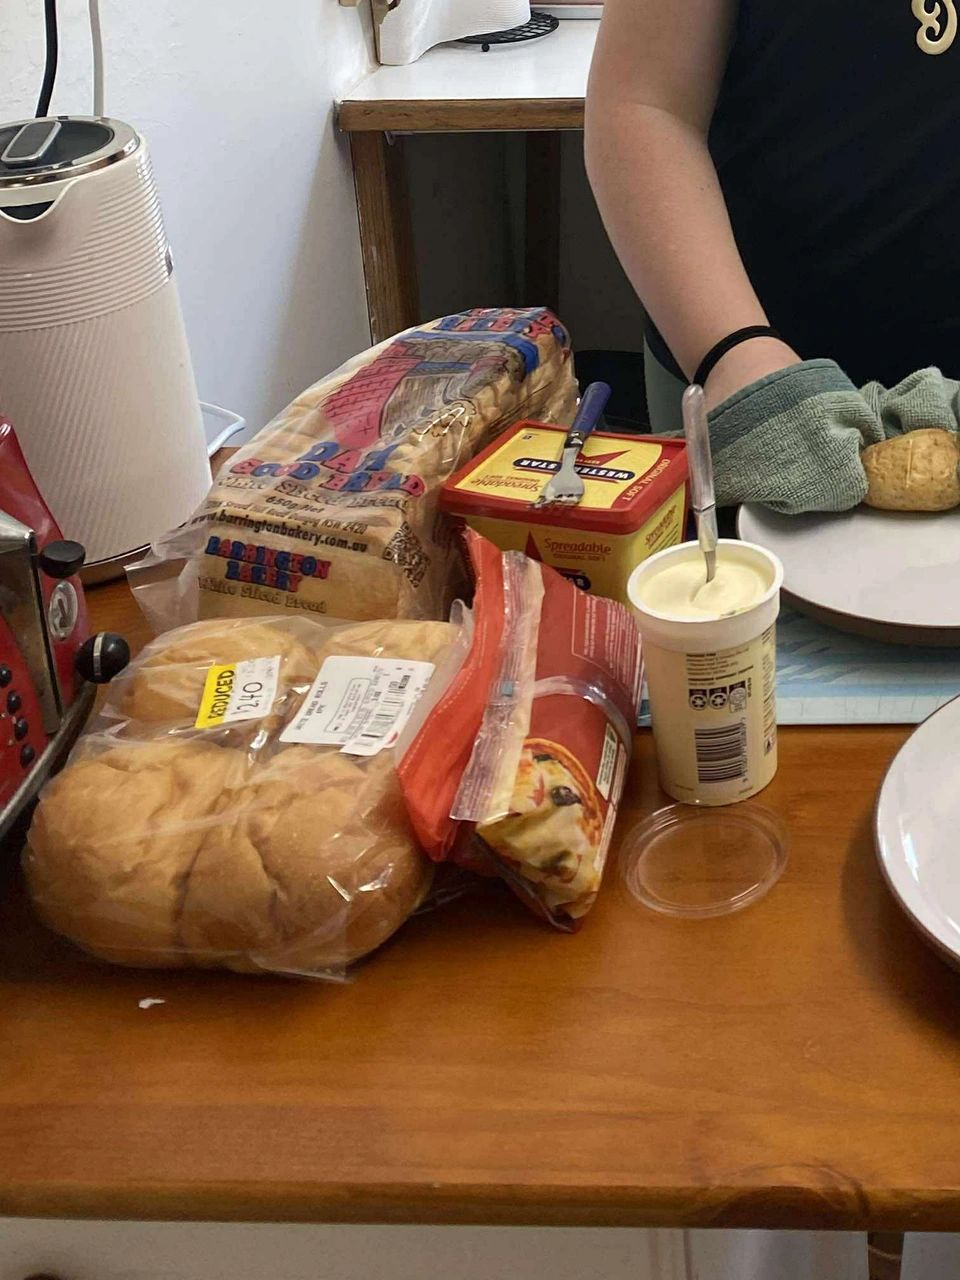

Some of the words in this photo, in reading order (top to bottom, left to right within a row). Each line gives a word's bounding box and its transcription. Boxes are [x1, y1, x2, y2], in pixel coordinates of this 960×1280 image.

[229, 457, 321, 481] GOOD
[519, 459, 558, 470] STAR
[575, 466, 630, 480] WESTER
[638, 458, 671, 486] ORIGINAL
[621, 485, 643, 501] SOFT
[265, 495, 301, 511] 650g
[301, 502, 325, 514] Net
[342, 521, 369, 535] 2420
[543, 537, 612, 555] Spreadable
[204, 535, 332, 580] BARRINGTON
[225, 560, 303, 593] BAKERY
[207, 669, 235, 719] REDUCED
